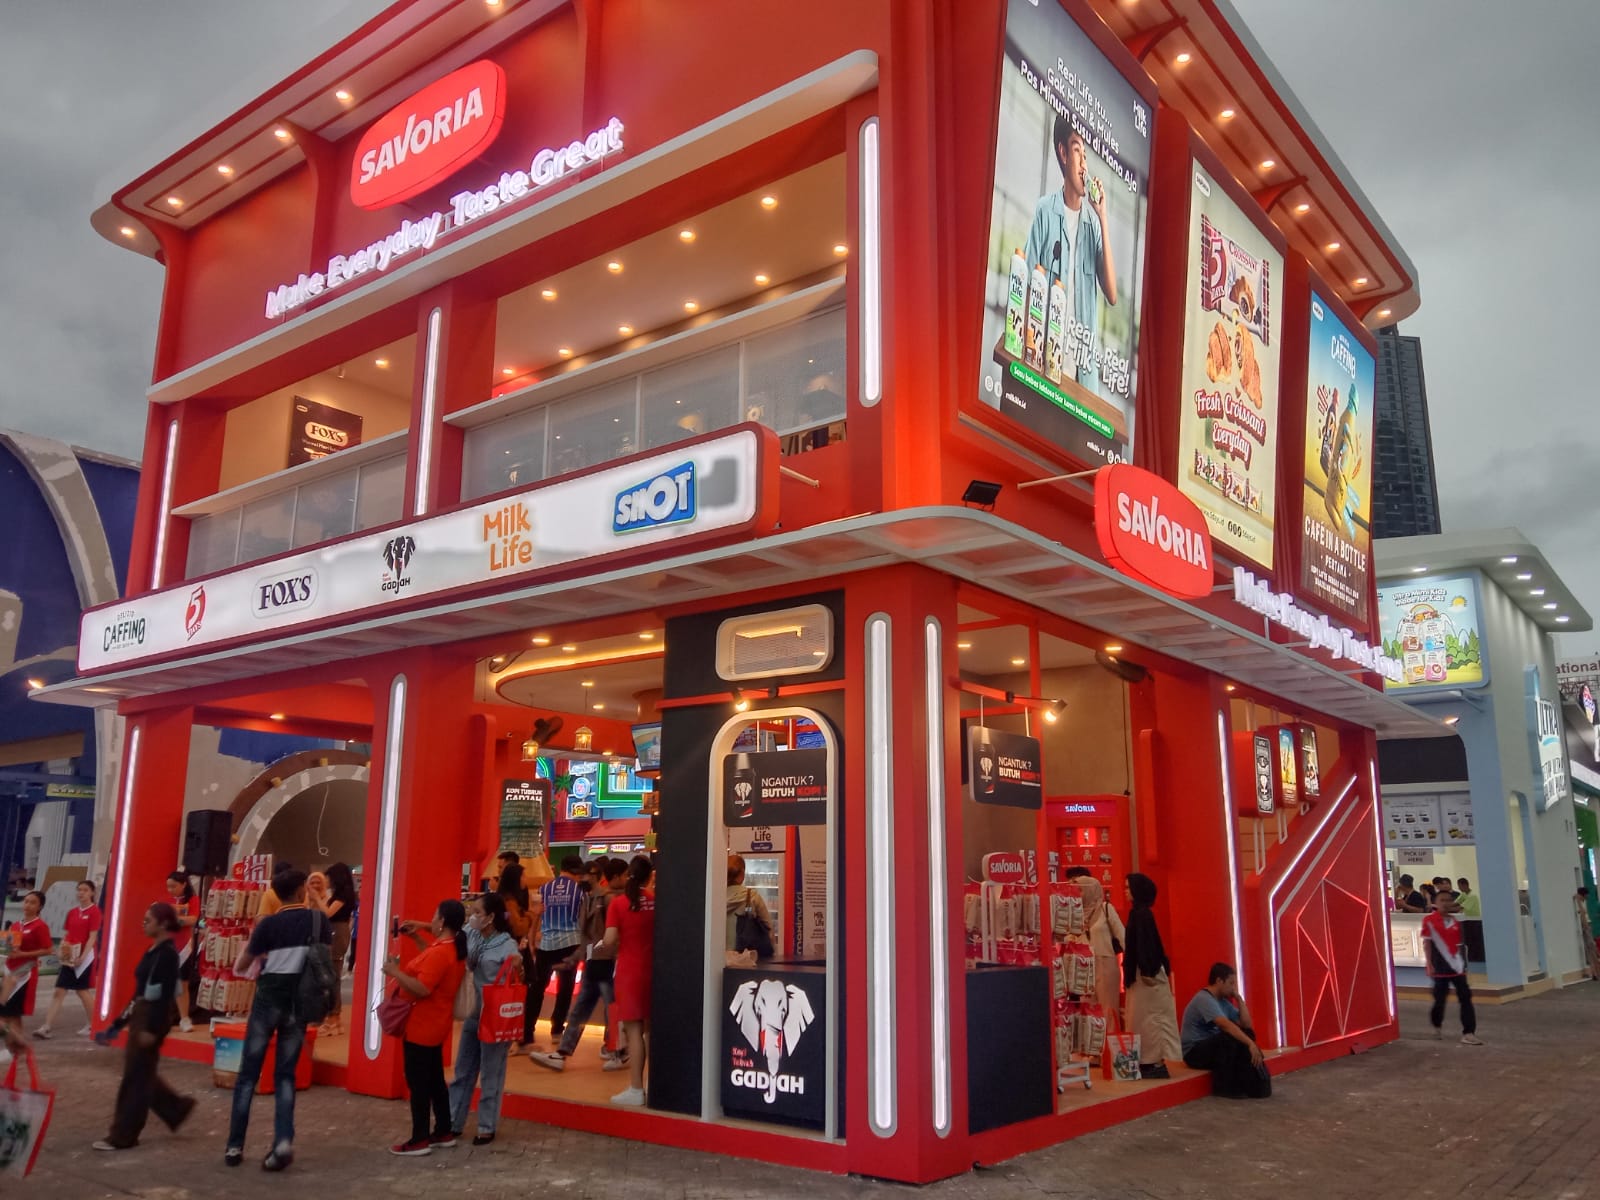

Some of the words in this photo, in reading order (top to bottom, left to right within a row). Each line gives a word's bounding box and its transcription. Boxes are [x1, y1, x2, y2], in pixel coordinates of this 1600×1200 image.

[1057, 57, 1077, 87] Real
[1078, 79, 1093, 105] Life
[1020, 59, 1038, 90] Pas
[1039, 79, 1070, 122] Minum
[1071, 114, 1092, 145] Susu
[1092, 133, 1101, 154] di
[1102, 144, 1123, 179] Mana
[1124, 168, 1137, 193] Aja
[1047, 67, 1065, 98] Gak
[1089, 114, 1096, 130] &
[1097, 119, 1120, 154] Mules
[1133, 100, 1147, 125] Milk
[359, 87, 484, 185] SAVORIA
[265, 271, 325, 319] Make
[327, 212, 442, 288] Everyday
[450, 170, 530, 226] Taste
[530, 116, 625, 187] Great
[1067, 316, 1095, 351] Real
[1065, 333, 1092, 373] Milk
[1104, 347, 1129, 378] Real
[1102, 364, 1130, 398] Life!
[1195, 389, 1222, 413] Fresh
[1224, 393, 1266, 438] Croissant
[1212, 421, 1251, 462] Everyday
[483, 502, 532, 542] Milk
[1117, 491, 1208, 570] SAVORIA
[490, 534, 533, 571] Life
[1305, 515, 1325, 546] CAFÉ
[1325, 529, 1334, 552] IN
[1333, 536, 1341, 557] A
[1340, 540, 1366, 572] BOTTLE
[258, 574, 313, 610] FOX'S
[103, 617, 146, 652] CAFFINO
[999, 767, 1021, 780] BUTUH
[761, 787, 795, 798] BUTUH
[1064, 803, 1096, 812] SAVORIA
[754, 831, 772, 841] Life
[990, 858, 1022, 873] SAVORIA
